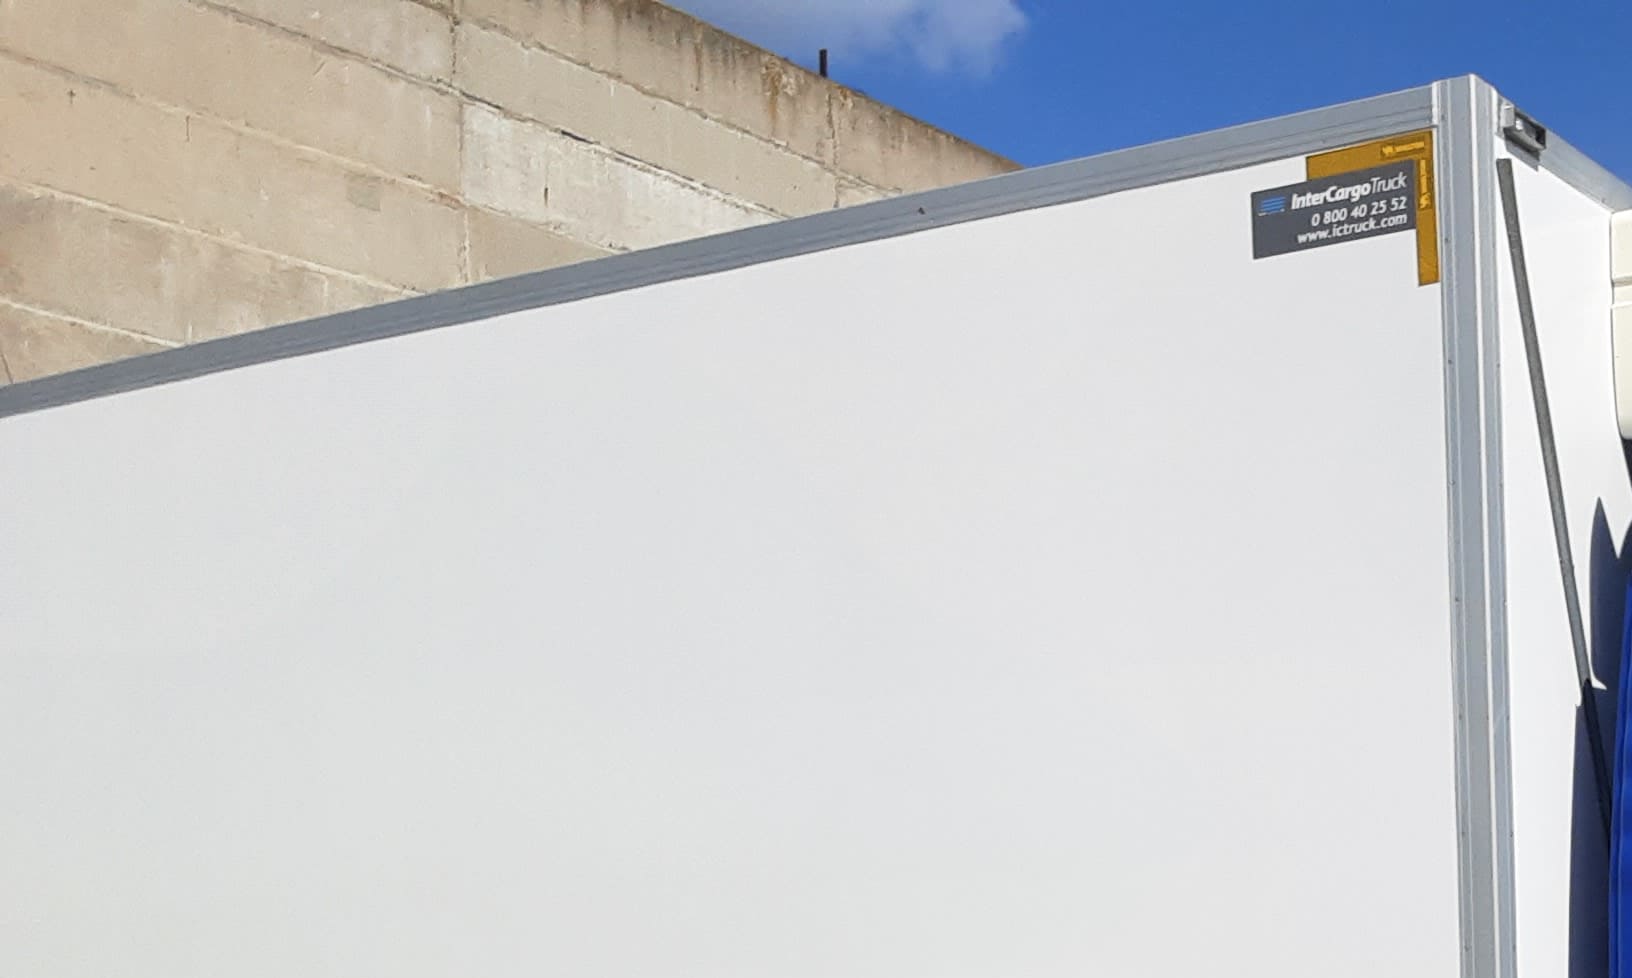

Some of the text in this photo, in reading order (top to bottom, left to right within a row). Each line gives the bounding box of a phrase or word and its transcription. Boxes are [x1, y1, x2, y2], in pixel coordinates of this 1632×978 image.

[1291, 172, 1407, 210] InterCargoTruck
[1311, 196, 1407, 226] 0 800 40 25 52
[1297, 213, 1408, 244] www.ictruck.com
